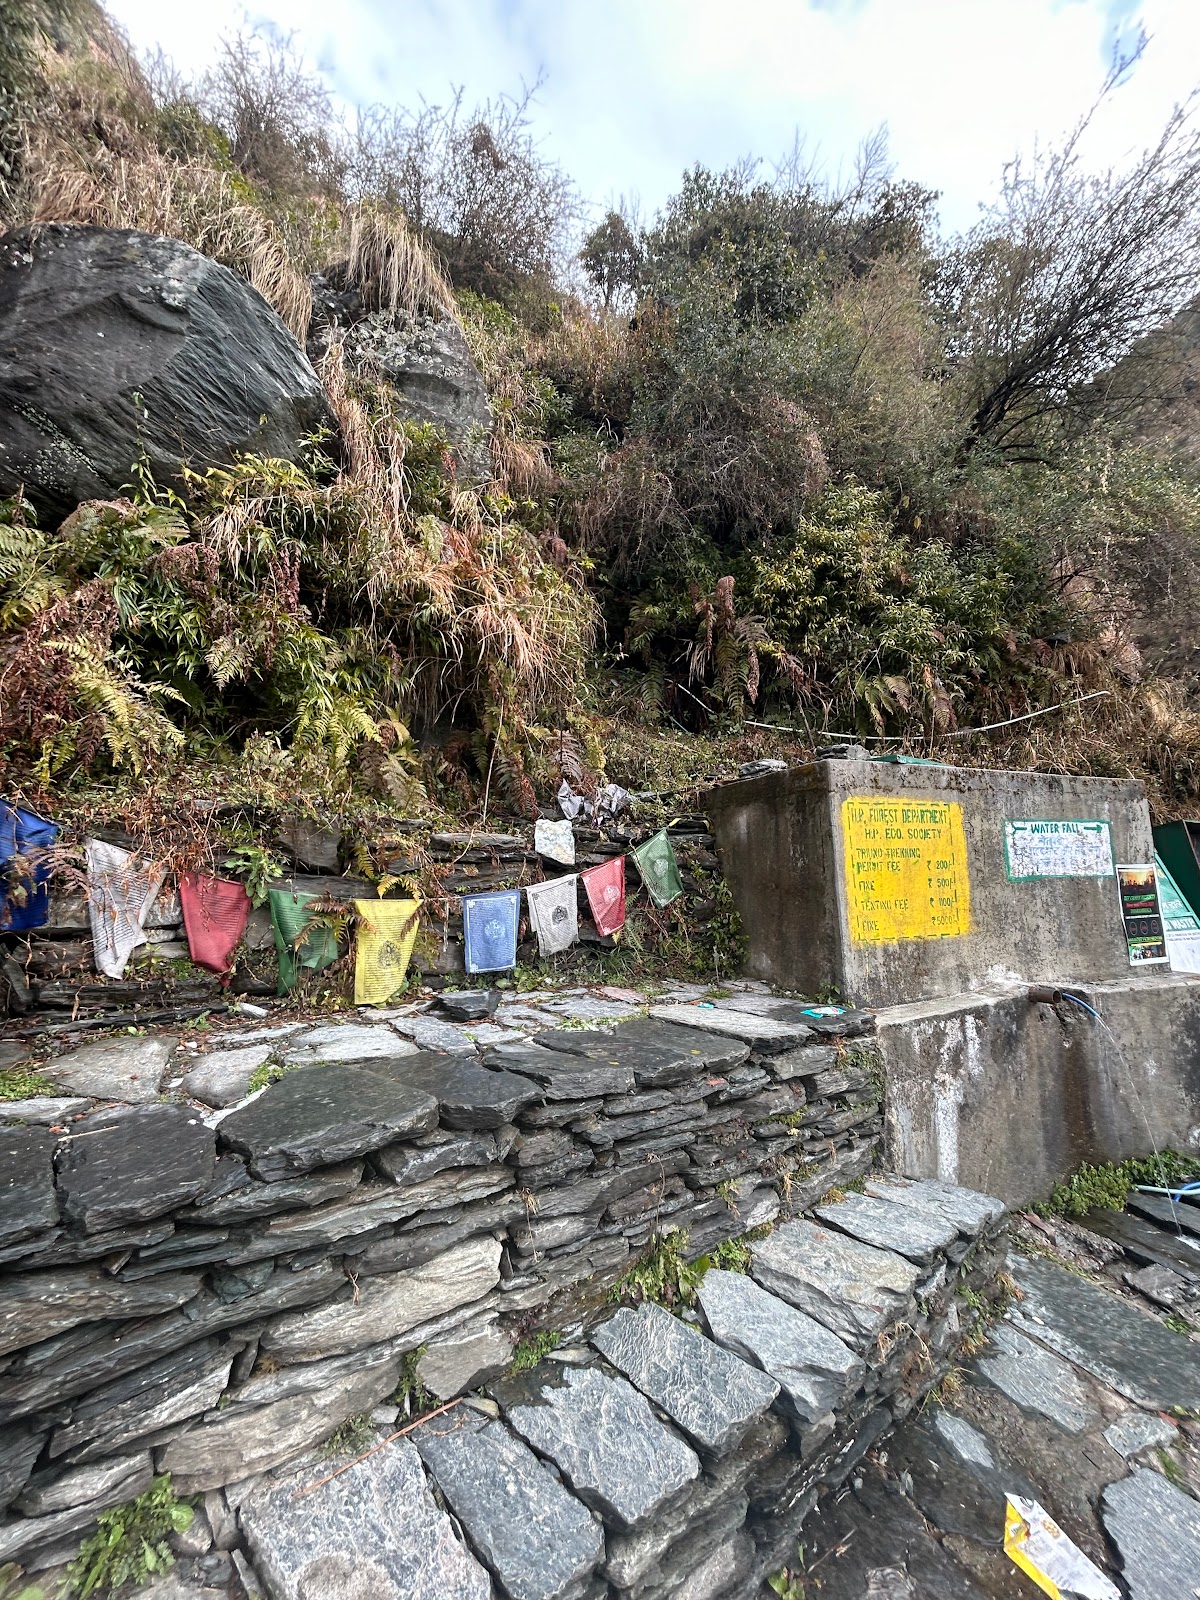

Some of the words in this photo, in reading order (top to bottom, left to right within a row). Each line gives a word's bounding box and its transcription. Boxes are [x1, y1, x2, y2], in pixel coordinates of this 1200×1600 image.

[869, 808, 898, 823] FOREST
[902, 808, 948, 824] DEPARTMENT
[907, 828, 942, 840] SOCIETY
[1030, 823, 1060, 834] WATER
[1061, 822, 1080, 834] FALL
[856, 861, 883, 873] PERMIT
[887, 860, 901, 872] FEE
[859, 880, 876, 892] FINE
[894, 899, 909, 911] FEE
[862, 920, 879, 931] FINE
